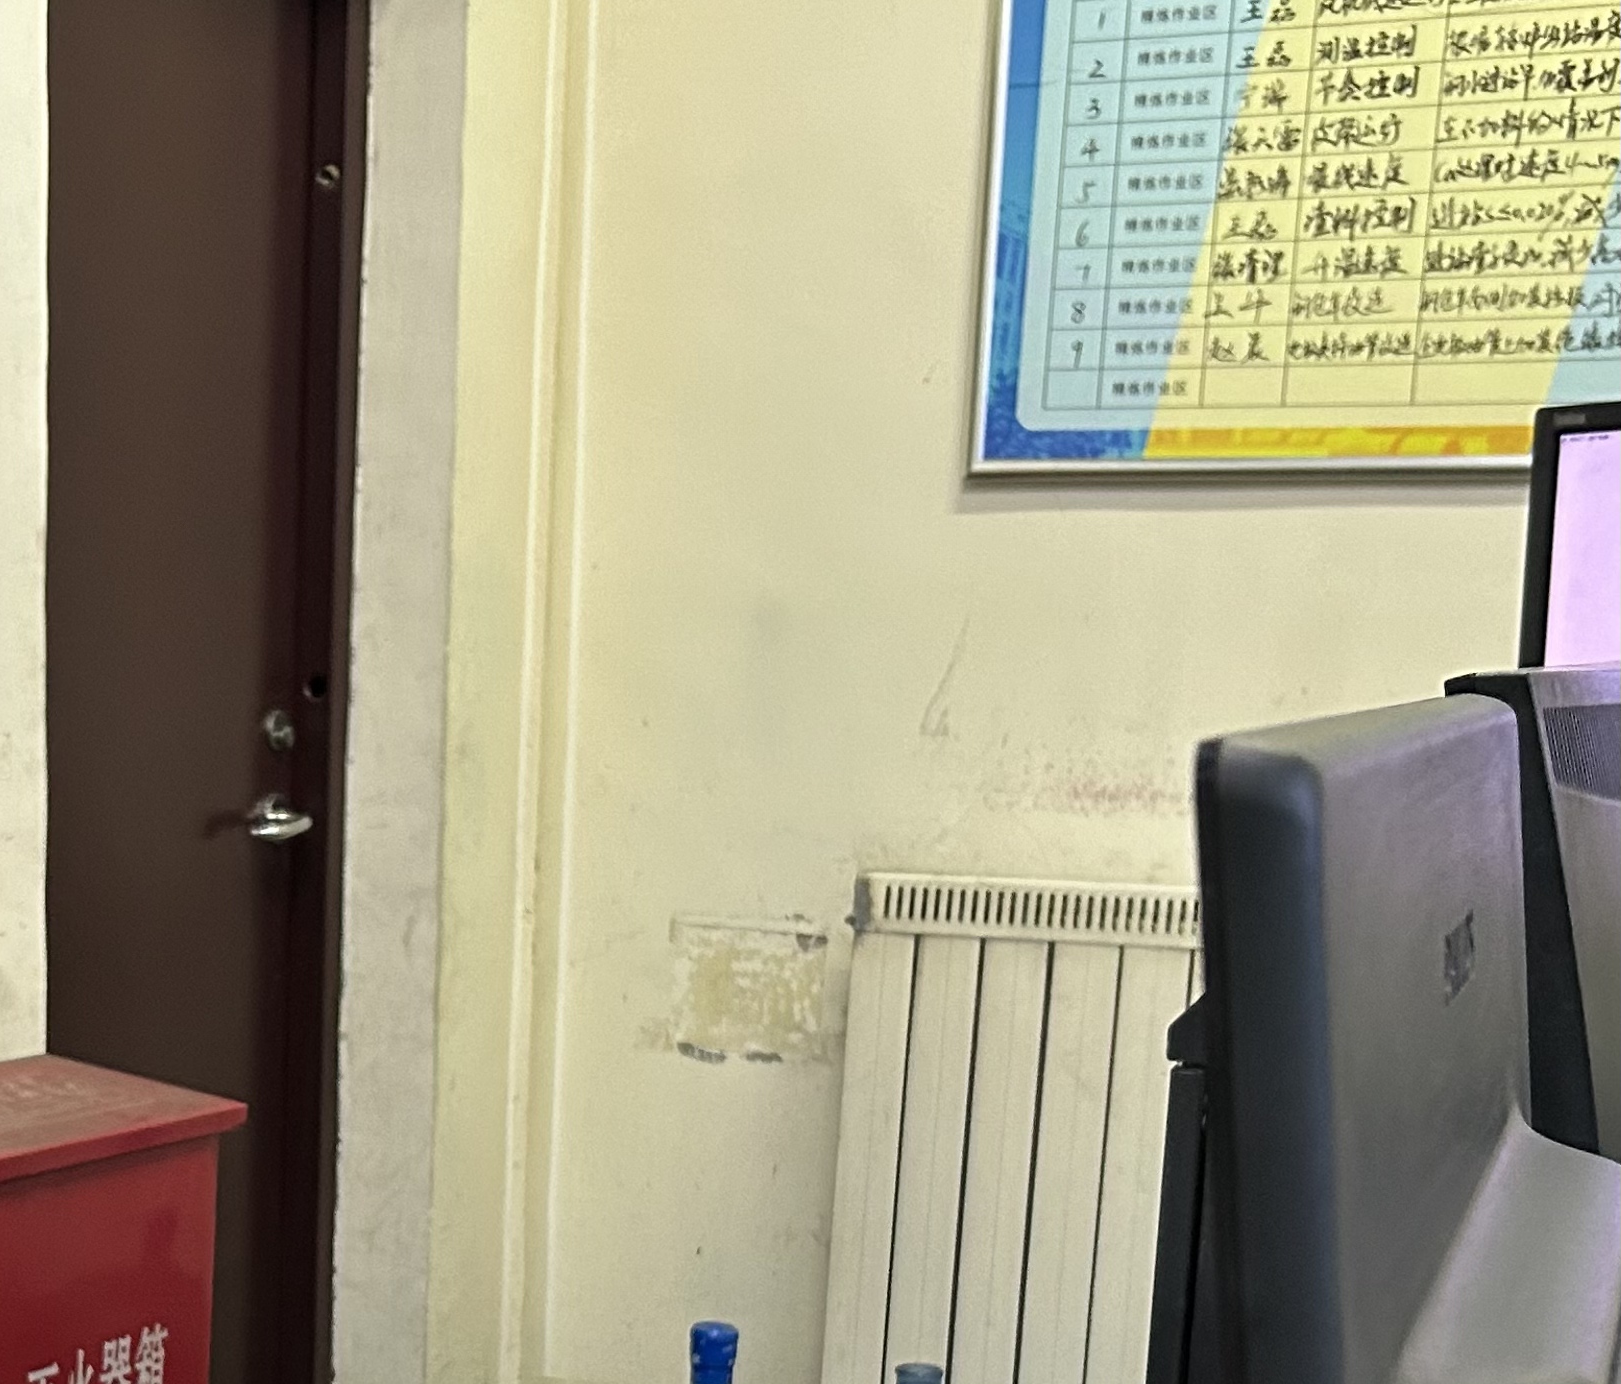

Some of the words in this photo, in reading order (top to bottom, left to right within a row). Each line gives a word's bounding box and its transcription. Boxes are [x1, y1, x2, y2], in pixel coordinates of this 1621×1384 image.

[1088, 59, 1107, 79] 2
[1085, 98, 1102, 120] 3
[1080, 138, 1100, 162] 4
[1074, 180, 1096, 204] 5
[1074, 220, 1090, 248] 6
[1075, 263, 1092, 283] 7
[1070, 301, 1087, 325] 8
[1070, 340, 1084, 369] 9
